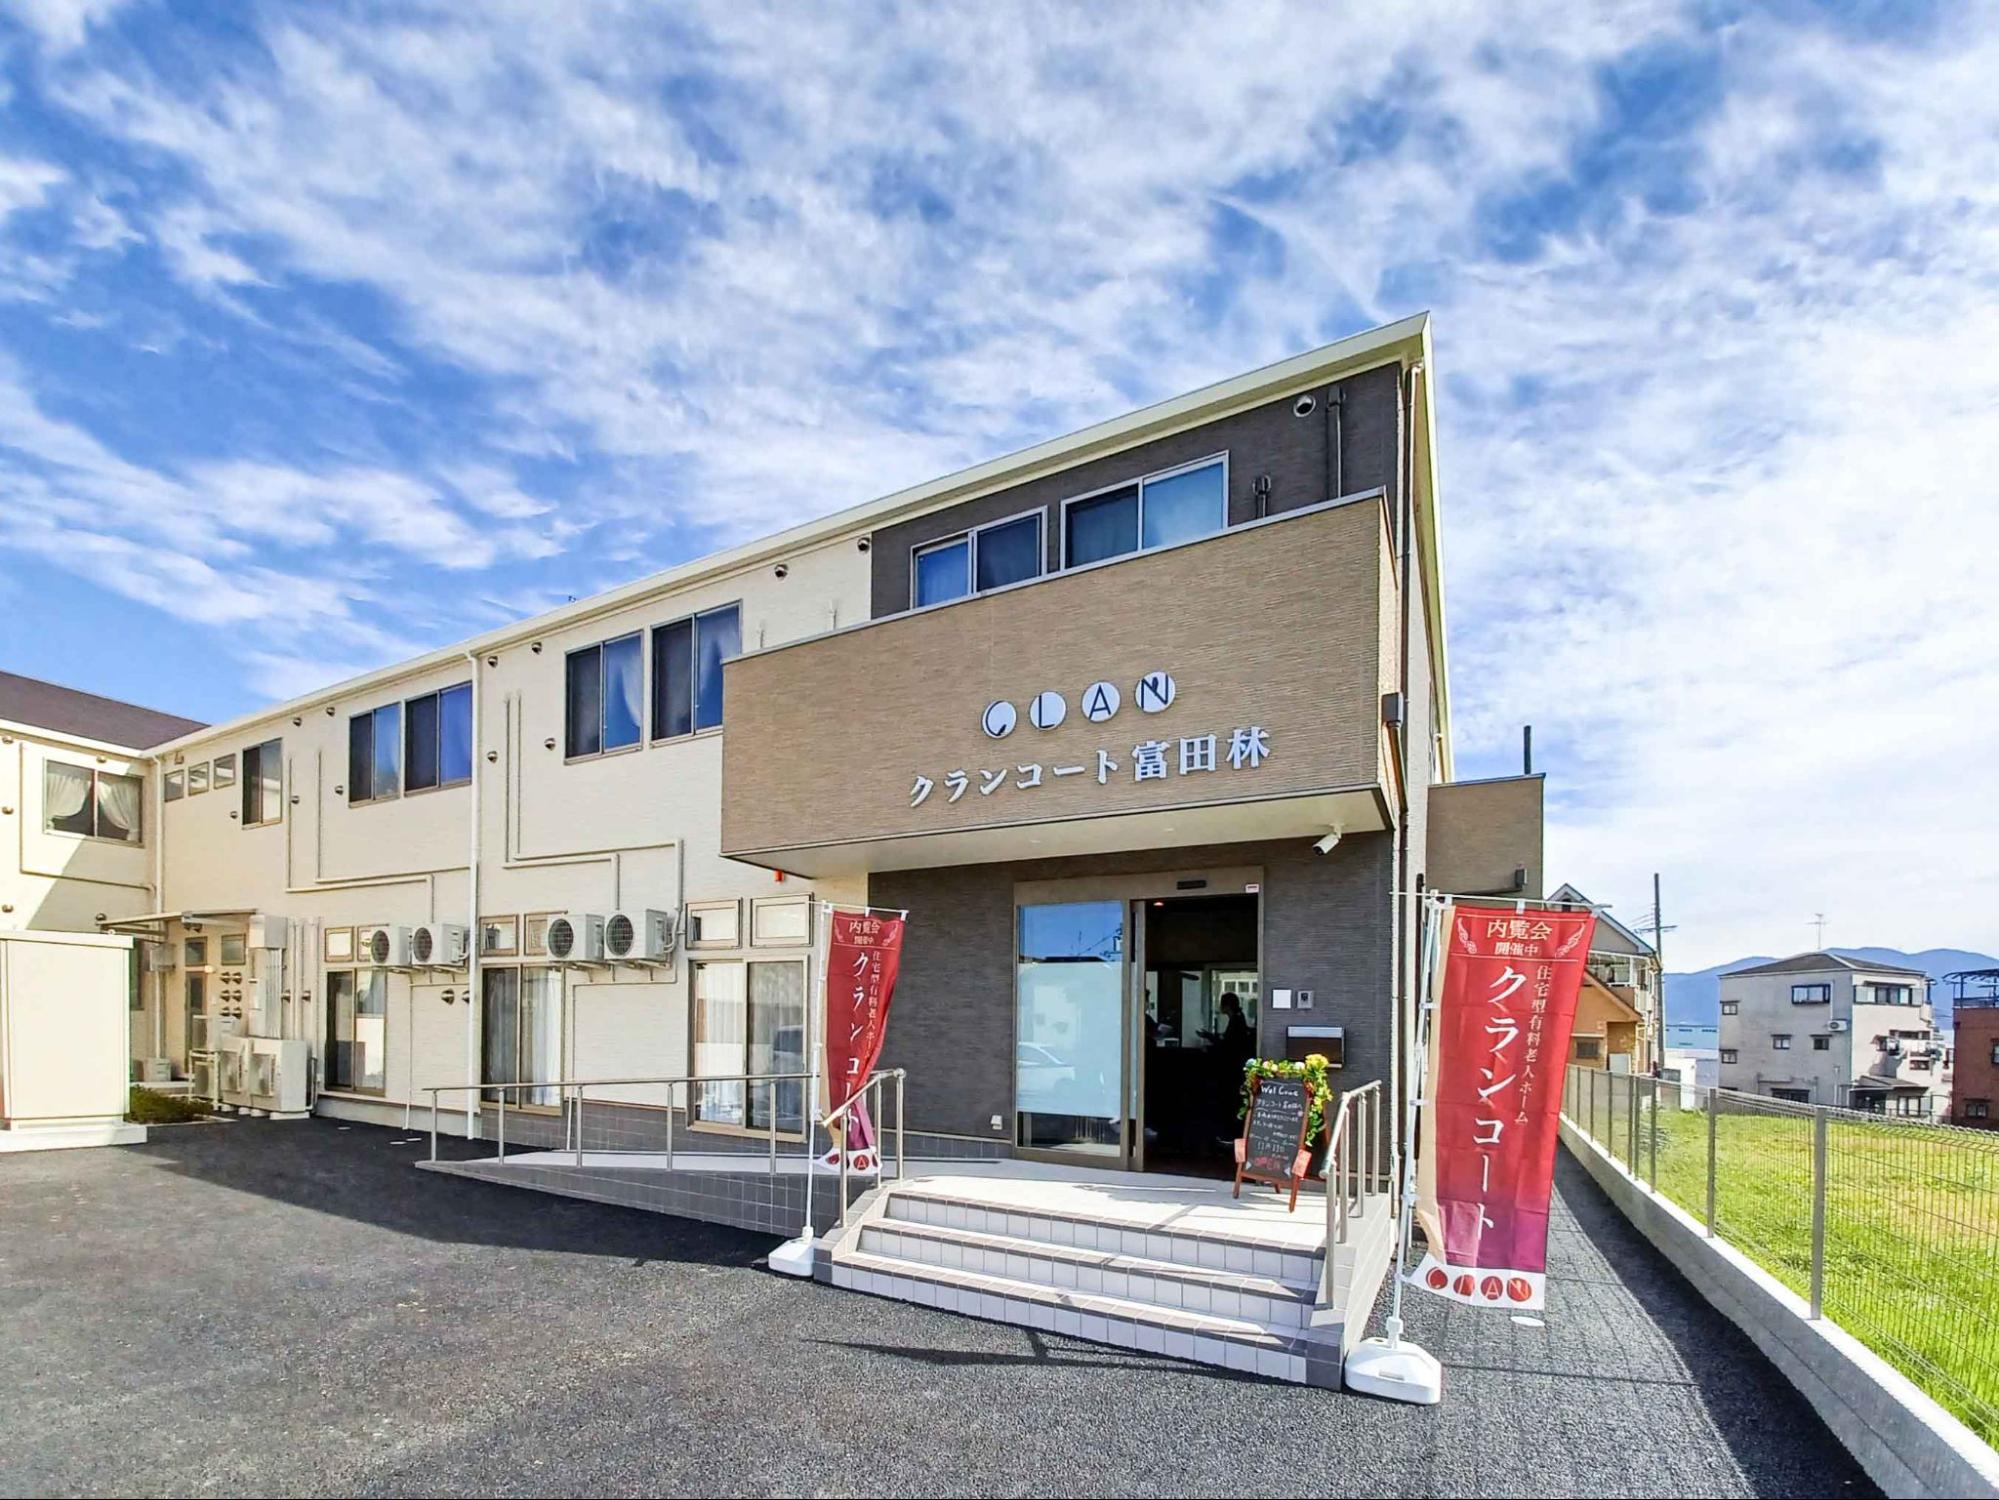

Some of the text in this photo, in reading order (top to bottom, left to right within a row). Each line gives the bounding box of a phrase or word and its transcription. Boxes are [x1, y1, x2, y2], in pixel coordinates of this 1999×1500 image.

[981, 670, 1177, 739] CLAN
[910, 726, 1271, 809] クランコート富田林
[1486, 918, 1553, 941] 内覧会
[1494, 941, 1539, 957] 開催中
[1514, 965, 1552, 1125] 住宅型有料老人ホーム
[1471, 965, 1528, 1241] クランコート
